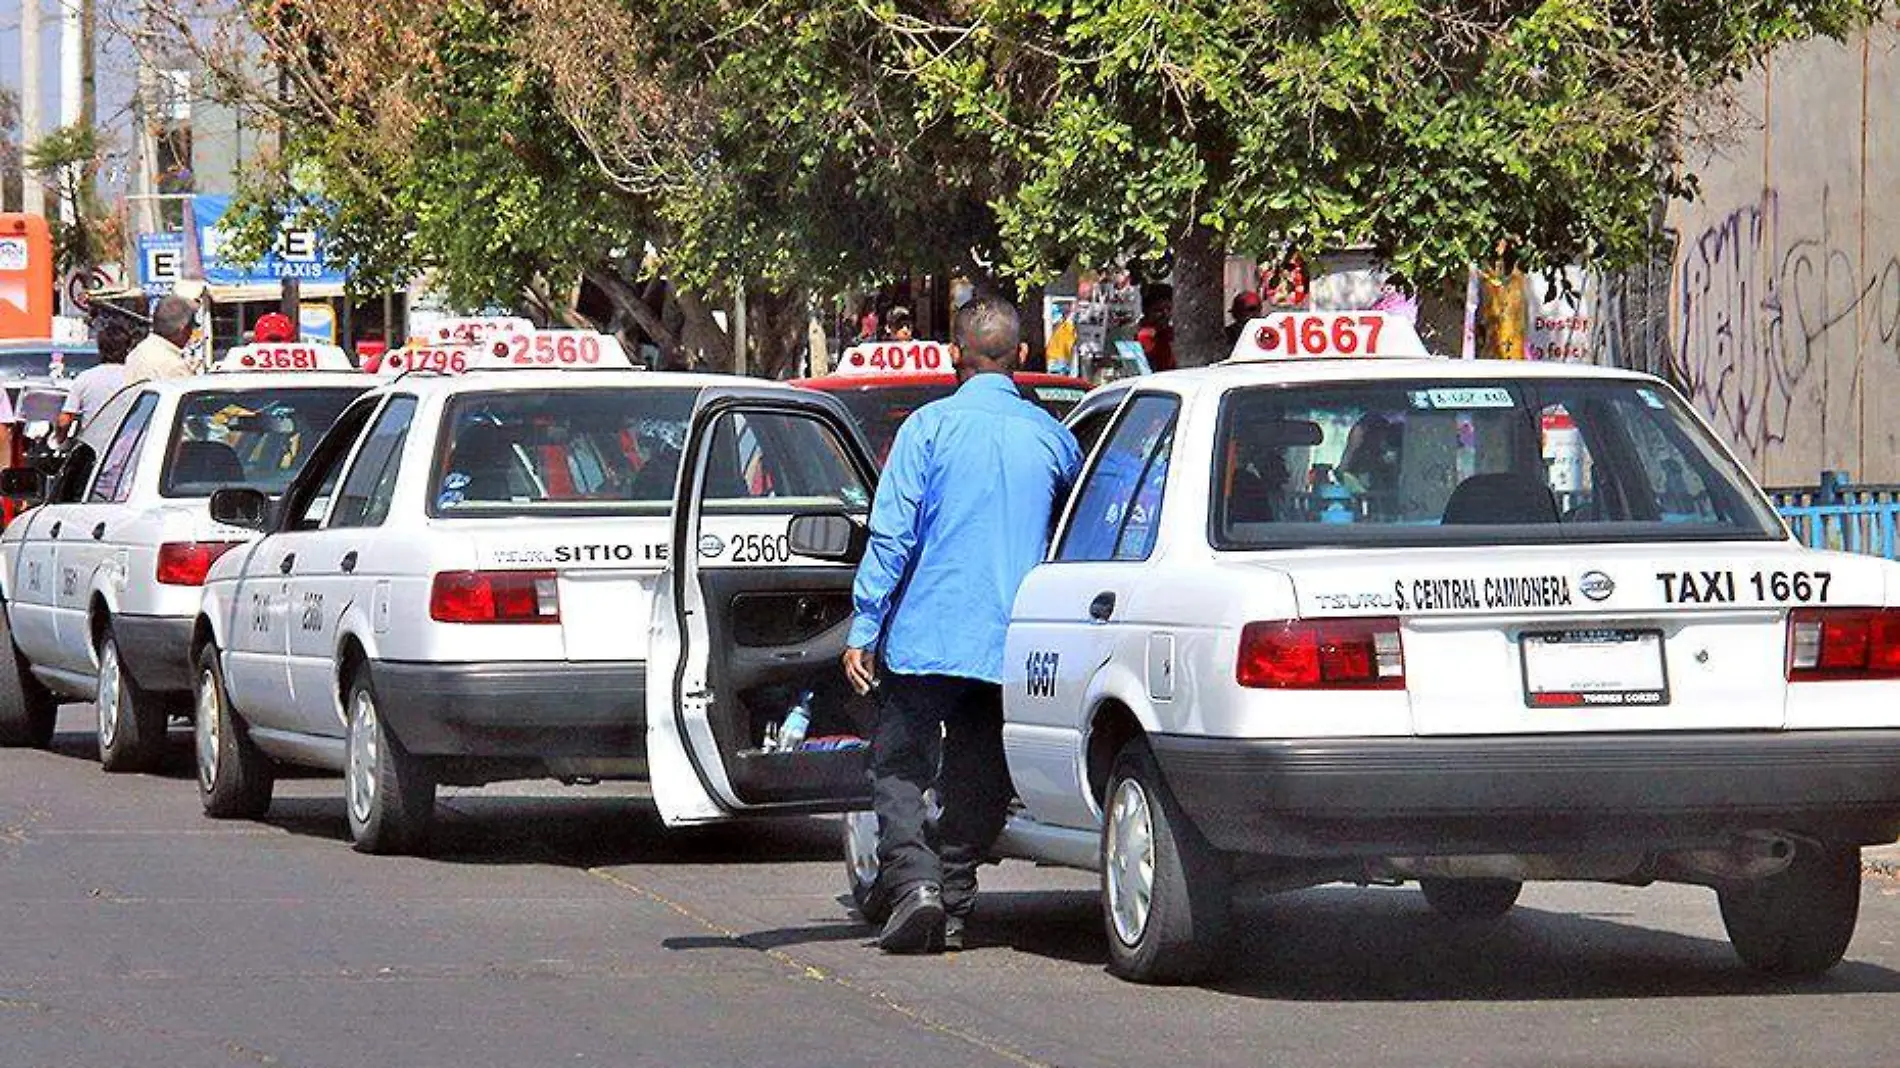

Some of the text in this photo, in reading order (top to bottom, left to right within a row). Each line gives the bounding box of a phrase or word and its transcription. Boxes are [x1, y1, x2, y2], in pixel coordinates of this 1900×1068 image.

[286, 228, 309, 256] E
[154, 252, 175, 277] E
[272, 263, 323, 277] TAXIS
[1279, 315, 1385, 355] 1667
[256, 349, 318, 369] 3681
[404, 348, 467, 375] 1796
[511, 335, 600, 365] 2560
[869, 344, 941, 370] 4010
[555, 544, 633, 562] SITIO
[731, 534, 790, 562] 2560
[1394, 580, 1411, 611] S.
[1413, 578, 1481, 610] CENTRAL
[1483, 575, 1572, 608] CAMIONERA
[1656, 570, 1832, 603] TAXI 1667
[1026, 651, 1060, 697] 1667
